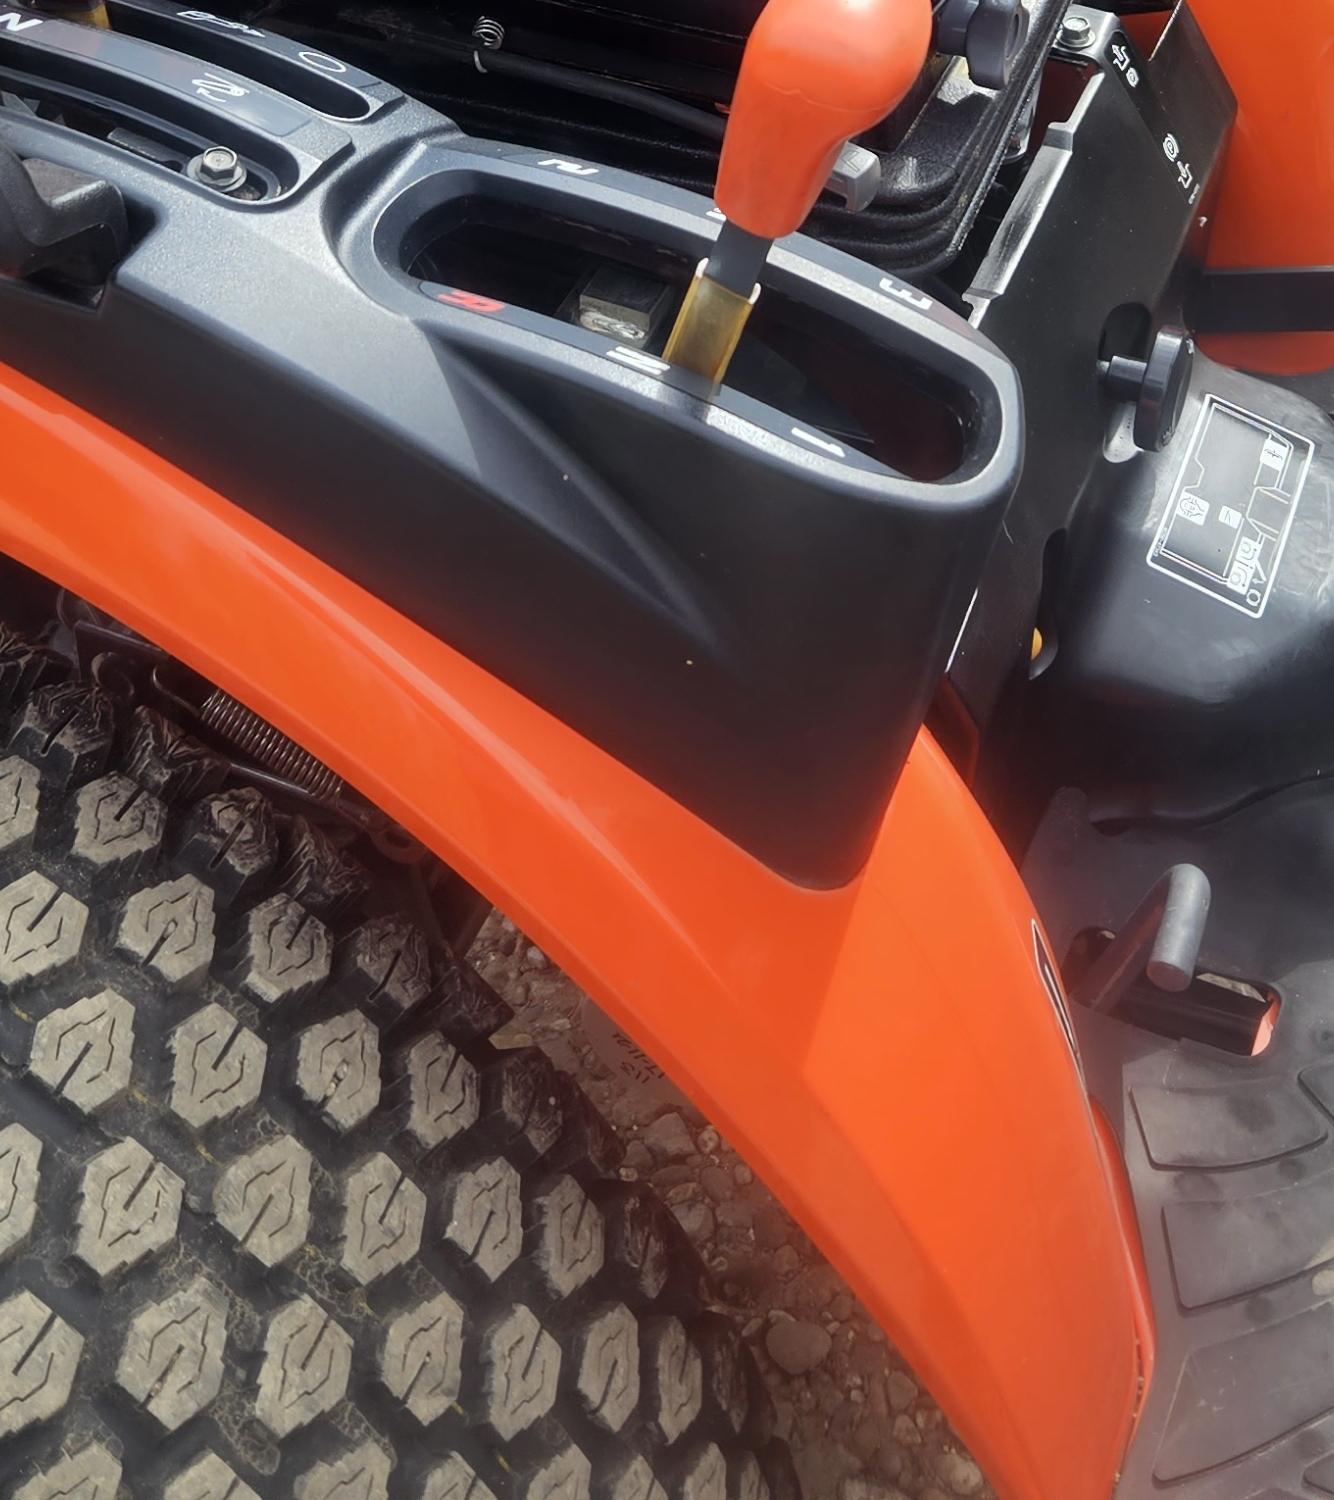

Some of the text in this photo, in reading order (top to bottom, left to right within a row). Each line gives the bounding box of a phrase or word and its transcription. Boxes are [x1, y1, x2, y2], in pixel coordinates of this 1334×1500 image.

[879, 277, 933, 310] 3
[606, 346, 671, 376] N
[791, 426, 846, 458] 1
